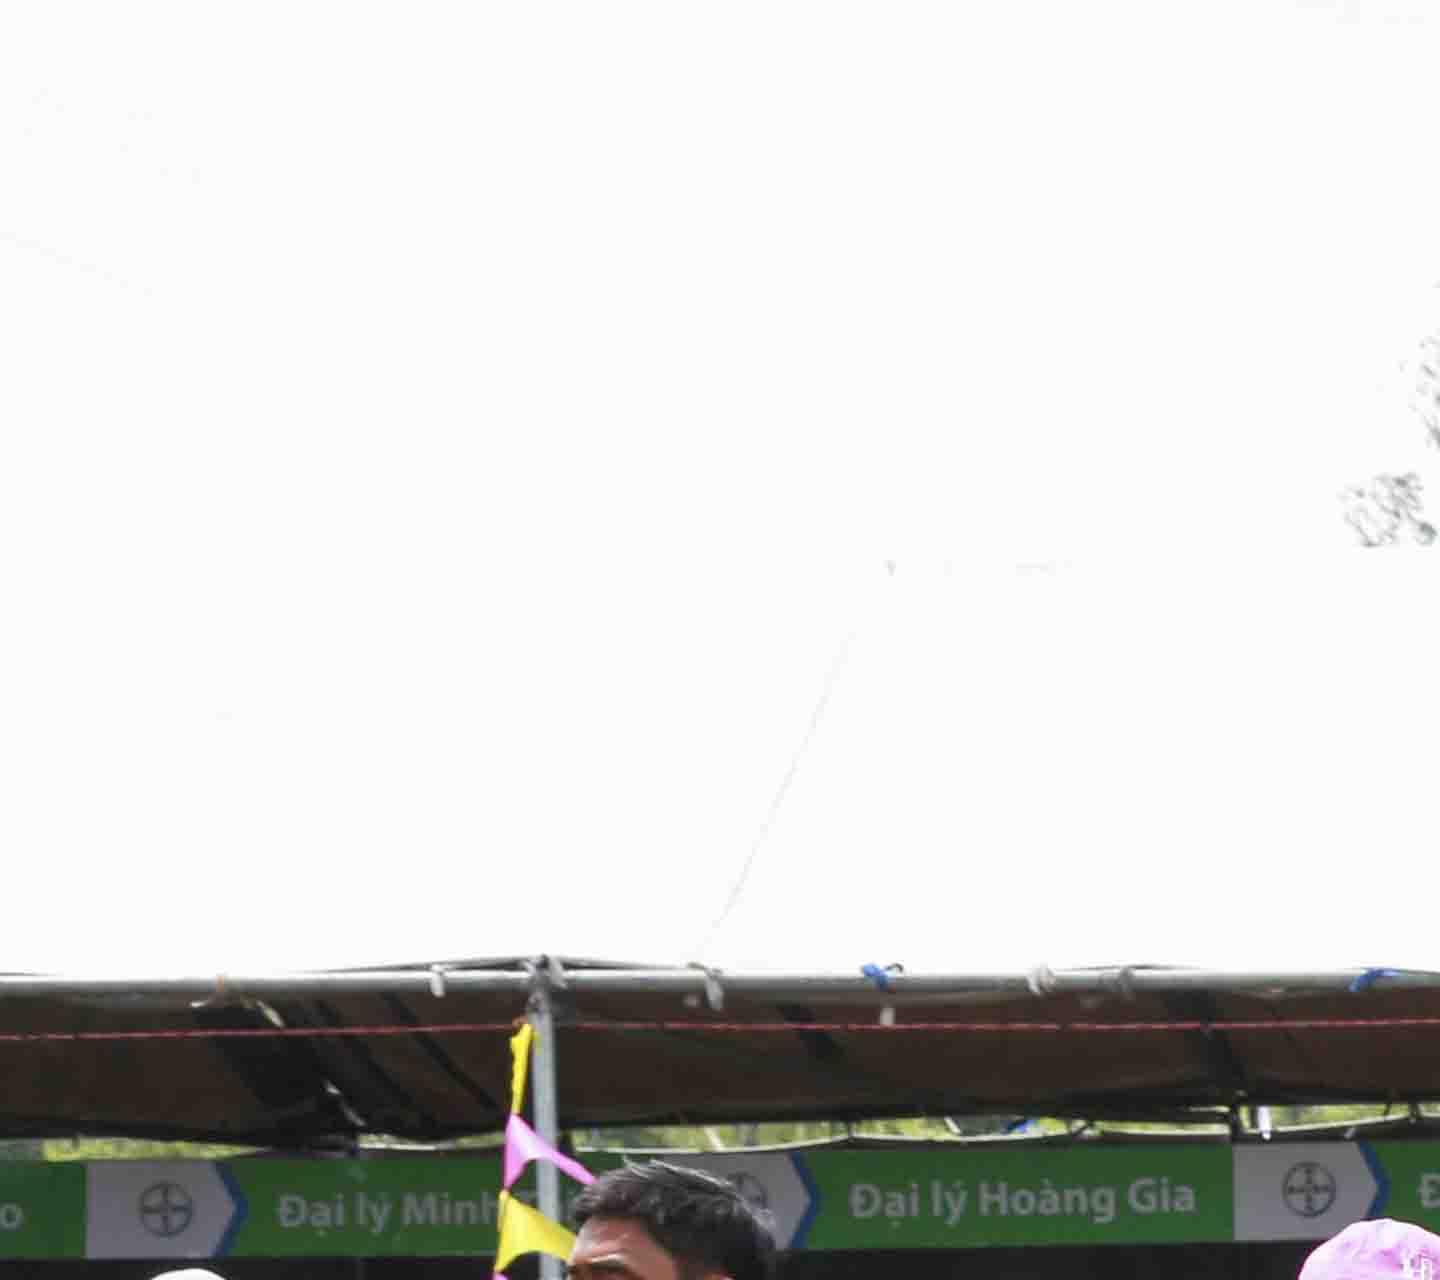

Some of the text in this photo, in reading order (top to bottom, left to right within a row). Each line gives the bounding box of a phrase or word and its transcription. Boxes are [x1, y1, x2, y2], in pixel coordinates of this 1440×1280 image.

[277, 1194, 344, 1236] Đại
[357, 1192, 392, 1234] lý
[850, 1178, 1195, 1226] Đại lý Hoàng Gia
